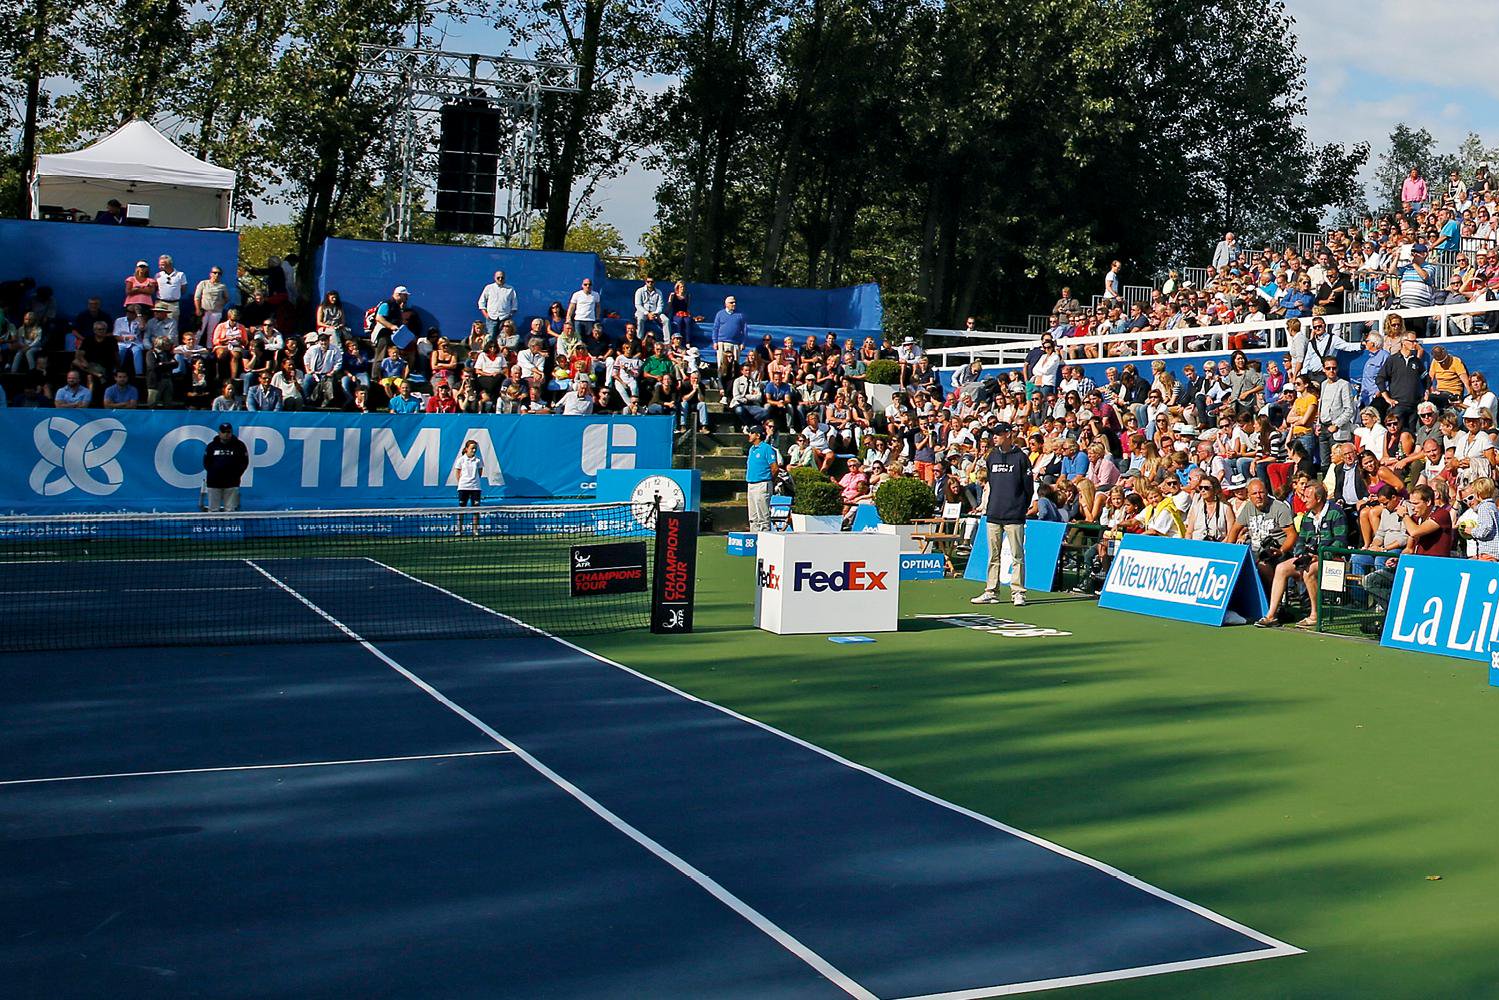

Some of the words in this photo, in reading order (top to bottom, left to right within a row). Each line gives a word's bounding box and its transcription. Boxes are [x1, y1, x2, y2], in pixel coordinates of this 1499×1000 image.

[154, 424, 505, 489] OPTIMA
[575, 570, 641, 583] CHAMPIONS
[664, 517, 680, 600] CHAMPIONS
[793, 561, 888, 592] FedEx
[901, 559, 941, 569] OPTIMA
[576, 581, 607, 590] TOUR
[675, 562, 688, 599] TOUR
[1112, 555, 1228, 601] Nieuwsblad.be
[1391, 566, 1443, 647] La
